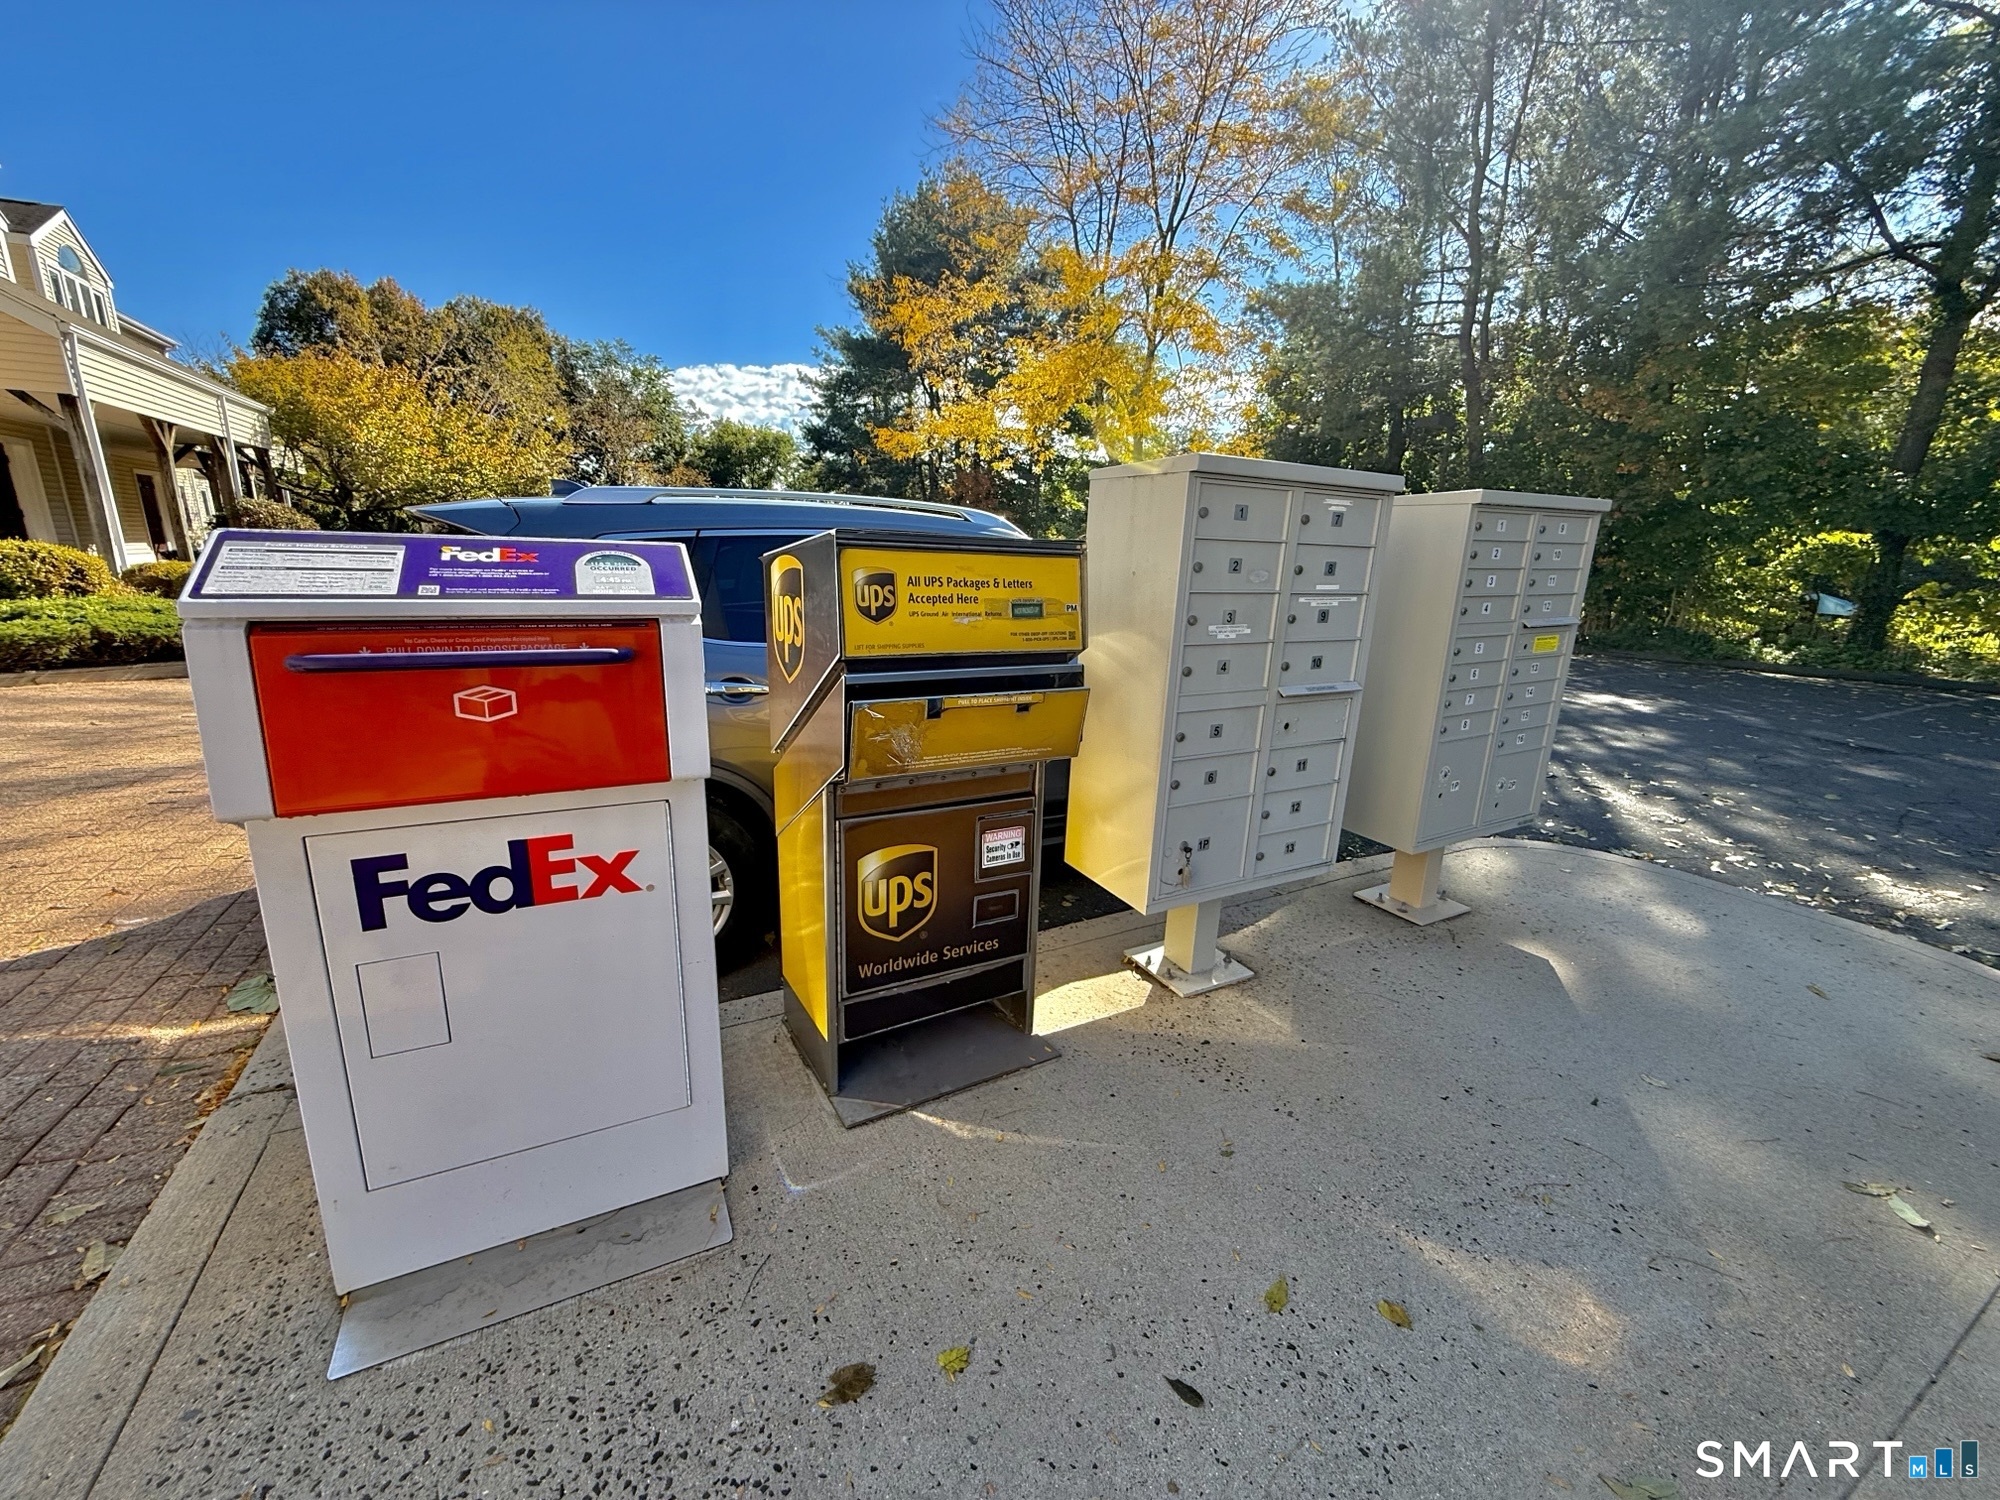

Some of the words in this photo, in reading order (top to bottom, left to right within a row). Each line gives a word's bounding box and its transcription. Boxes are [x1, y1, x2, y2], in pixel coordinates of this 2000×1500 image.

[1240, 508, 1243, 518] 1
[1335, 515, 1342, 526] 7
[441, 546, 539, 562] FedEx
[1494, 549, 1498, 557] 2
[1554, 551, 1561, 559] 10
[1233, 561, 1238, 571] 2
[1328, 564, 1334, 574] 8
[907, 576, 920, 587] All
[924, 576, 943, 587] UPS
[947, 577, 990, 591] Packages
[993, 578, 1000, 588] &
[1003, 578, 1033, 588] Letters
[1489, 577, 1494, 585] 3
[857, 584, 895, 616] ups
[908, 593, 953, 606] Accepted
[957, 593, 979, 604] Here
[1544, 602, 1550, 610] 12
[1227, 613, 1232, 623] 3
[1321, 612, 1326, 622] 9
[1477, 643, 1482, 652] 5
[1221, 662, 1226, 672] 4
[1312, 658, 1321, 668] 10
[1468, 695, 1472, 703] 7
[1214, 726, 1219, 736] 5
[1298, 761, 1306, 771] 11
[1208, 773, 1213, 782] 6
[1292, 802, 1300, 812] 12
[986, 829, 1021, 841] WARNING
[986, 844, 1006, 854] Security
[1199, 840, 1209, 849] 1P
[1286, 844, 1294, 853] 13
[986, 854, 1006, 862] Cameras
[350, 833, 644, 932] FedEx
[864, 872, 932, 928] ups
[859, 951, 938, 978] Worldwide
[943, 938, 999, 960] Services
